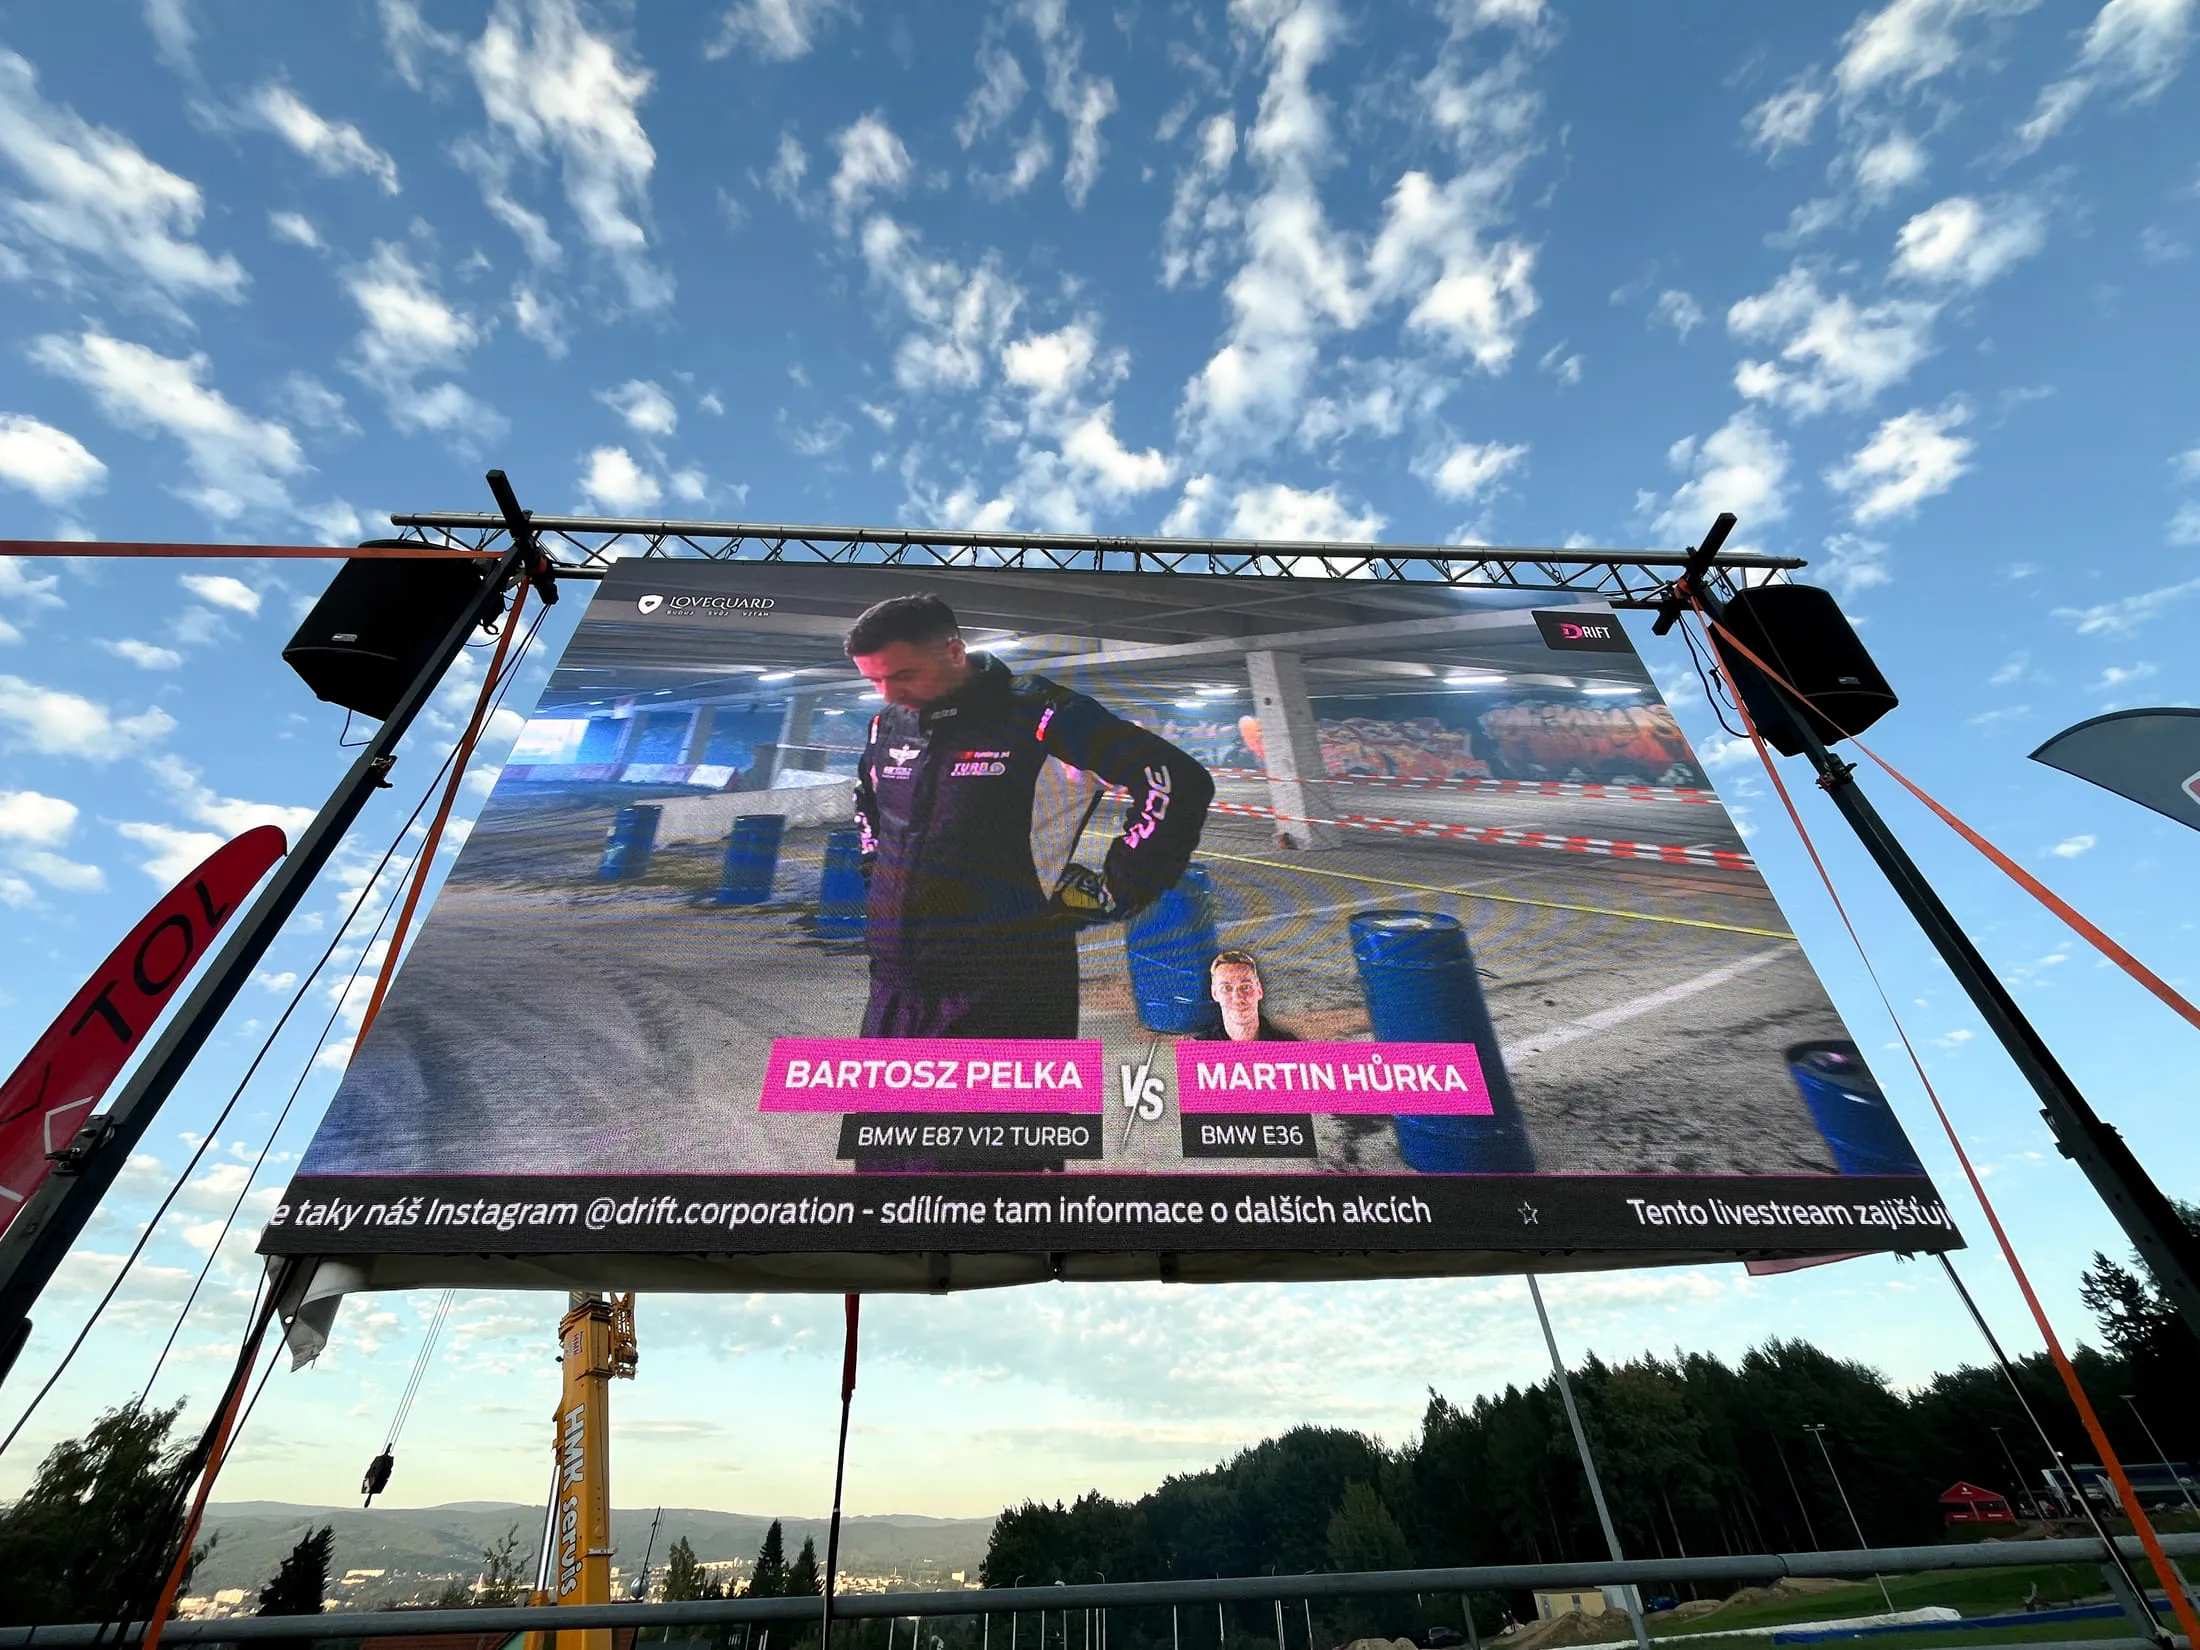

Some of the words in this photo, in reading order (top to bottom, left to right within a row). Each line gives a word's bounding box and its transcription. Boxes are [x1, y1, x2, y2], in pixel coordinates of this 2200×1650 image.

[670, 596, 775, 610] LOVEGUARD
[1560, 622, 1611, 639] DRIFT
[785, 1060, 959, 1089] BARTOSZ
[966, 1060, 1083, 1090] PELKA
[1197, 1062, 1337, 1091] MARTIN
[1345, 1053, 1469, 1092] HŮRKA
[1120, 1063, 1165, 1121] VS
[858, 1126, 917, 1146] BMW
[921, 1126, 964, 1146] E87
[968, 1126, 1004, 1146] V12
[1009, 1126, 1090, 1147] TURBO
[1201, 1125, 1257, 1145] BMW
[1262, 1125, 1304, 1146] E36
[294, 1198, 364, 1231] taky
[363, 1197, 424, 1226] náš
[424, 1199, 579, 1232] Instagram
[584, 1196, 855, 1230] @drift.corporation
[879, 1196, 986, 1224] sdílíme
[993, 1198, 1052, 1224] tam
[1059, 1196, 1204, 1223] informace
[1210, 1202, 1229, 1223] o
[1234, 1196, 1336, 1223] dalších
[1342, 1196, 1432, 1223] akcích
[1626, 1199, 1708, 1225] Tento
[1709, 1198, 1853, 1225] livestream
[1853, 1194, 1953, 1230] zajišťuj
[563, 1404, 584, 1491] HMK
[560, 1495, 583, 1597] servis
